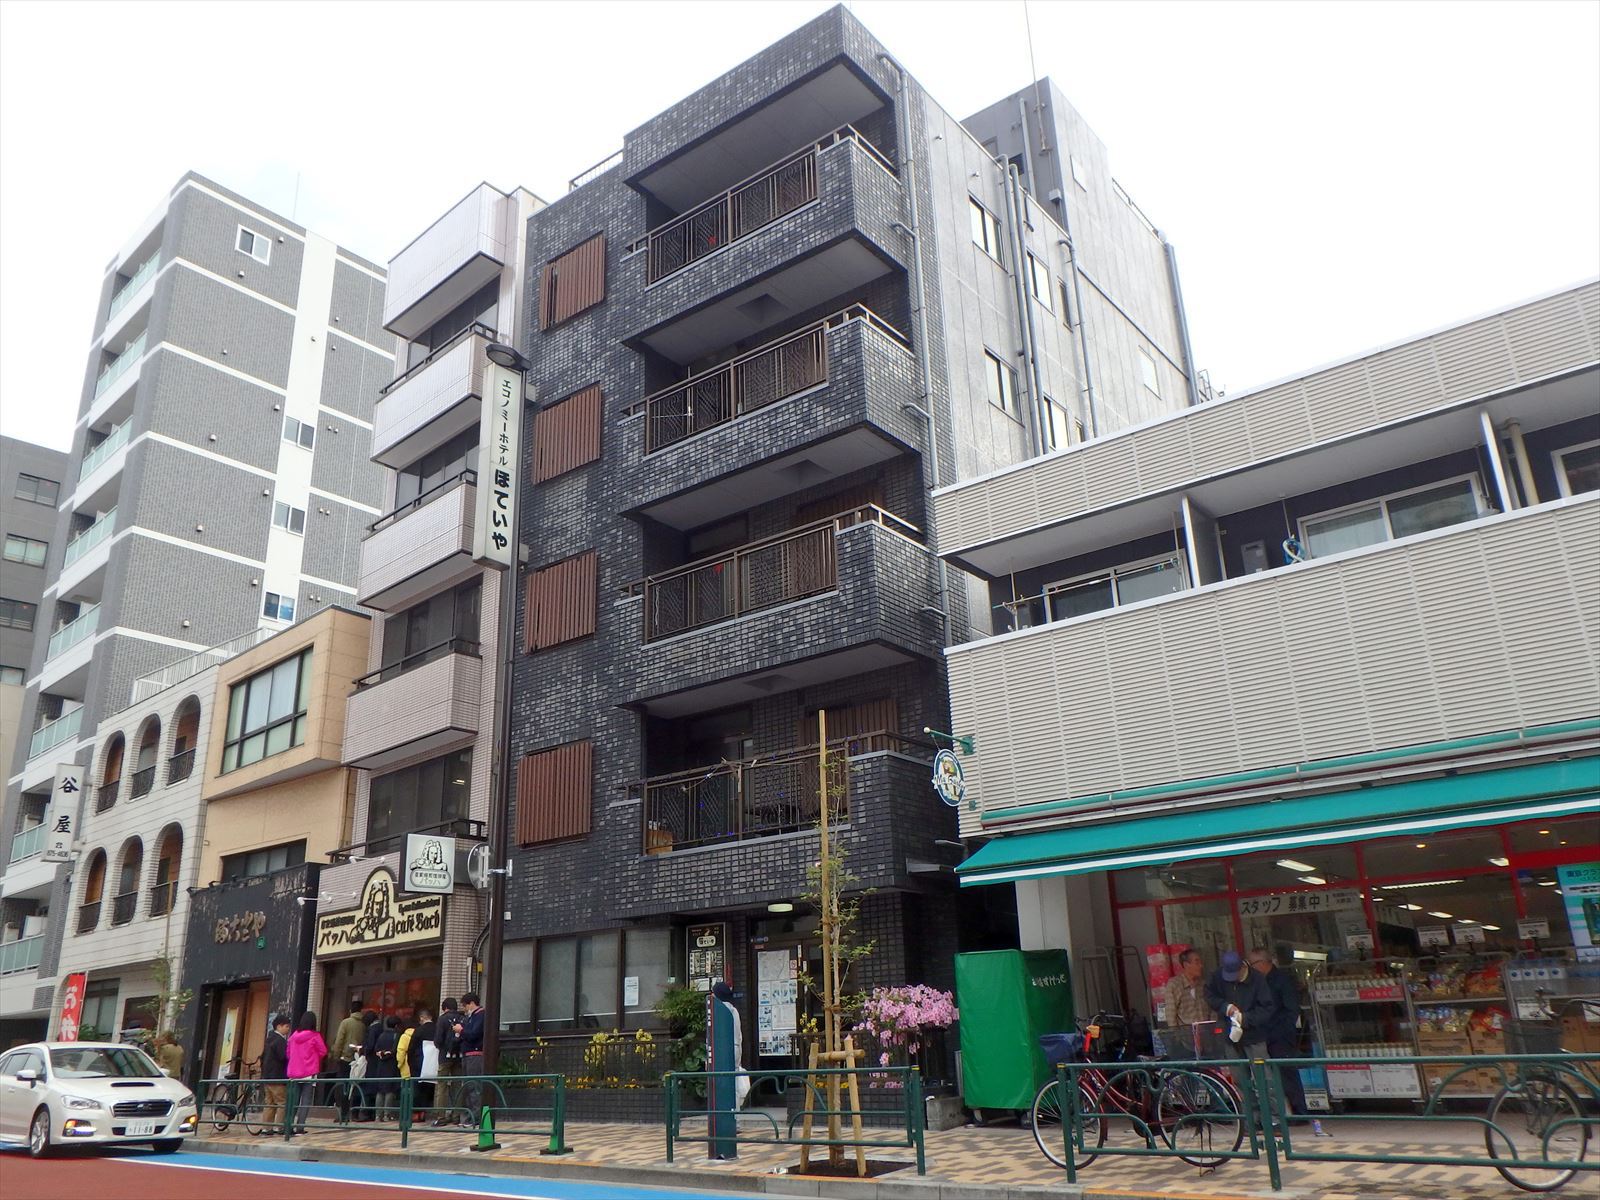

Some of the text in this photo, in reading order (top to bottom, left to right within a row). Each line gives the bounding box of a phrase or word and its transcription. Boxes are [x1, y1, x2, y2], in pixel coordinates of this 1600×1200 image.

[492, 379, 511, 550] エコノミーホテル ほていや
[52, 776, 80, 834] 谷屋
[1241, 896, 1281, 915] スタッフ
[318, 929, 350, 948] バッハ
